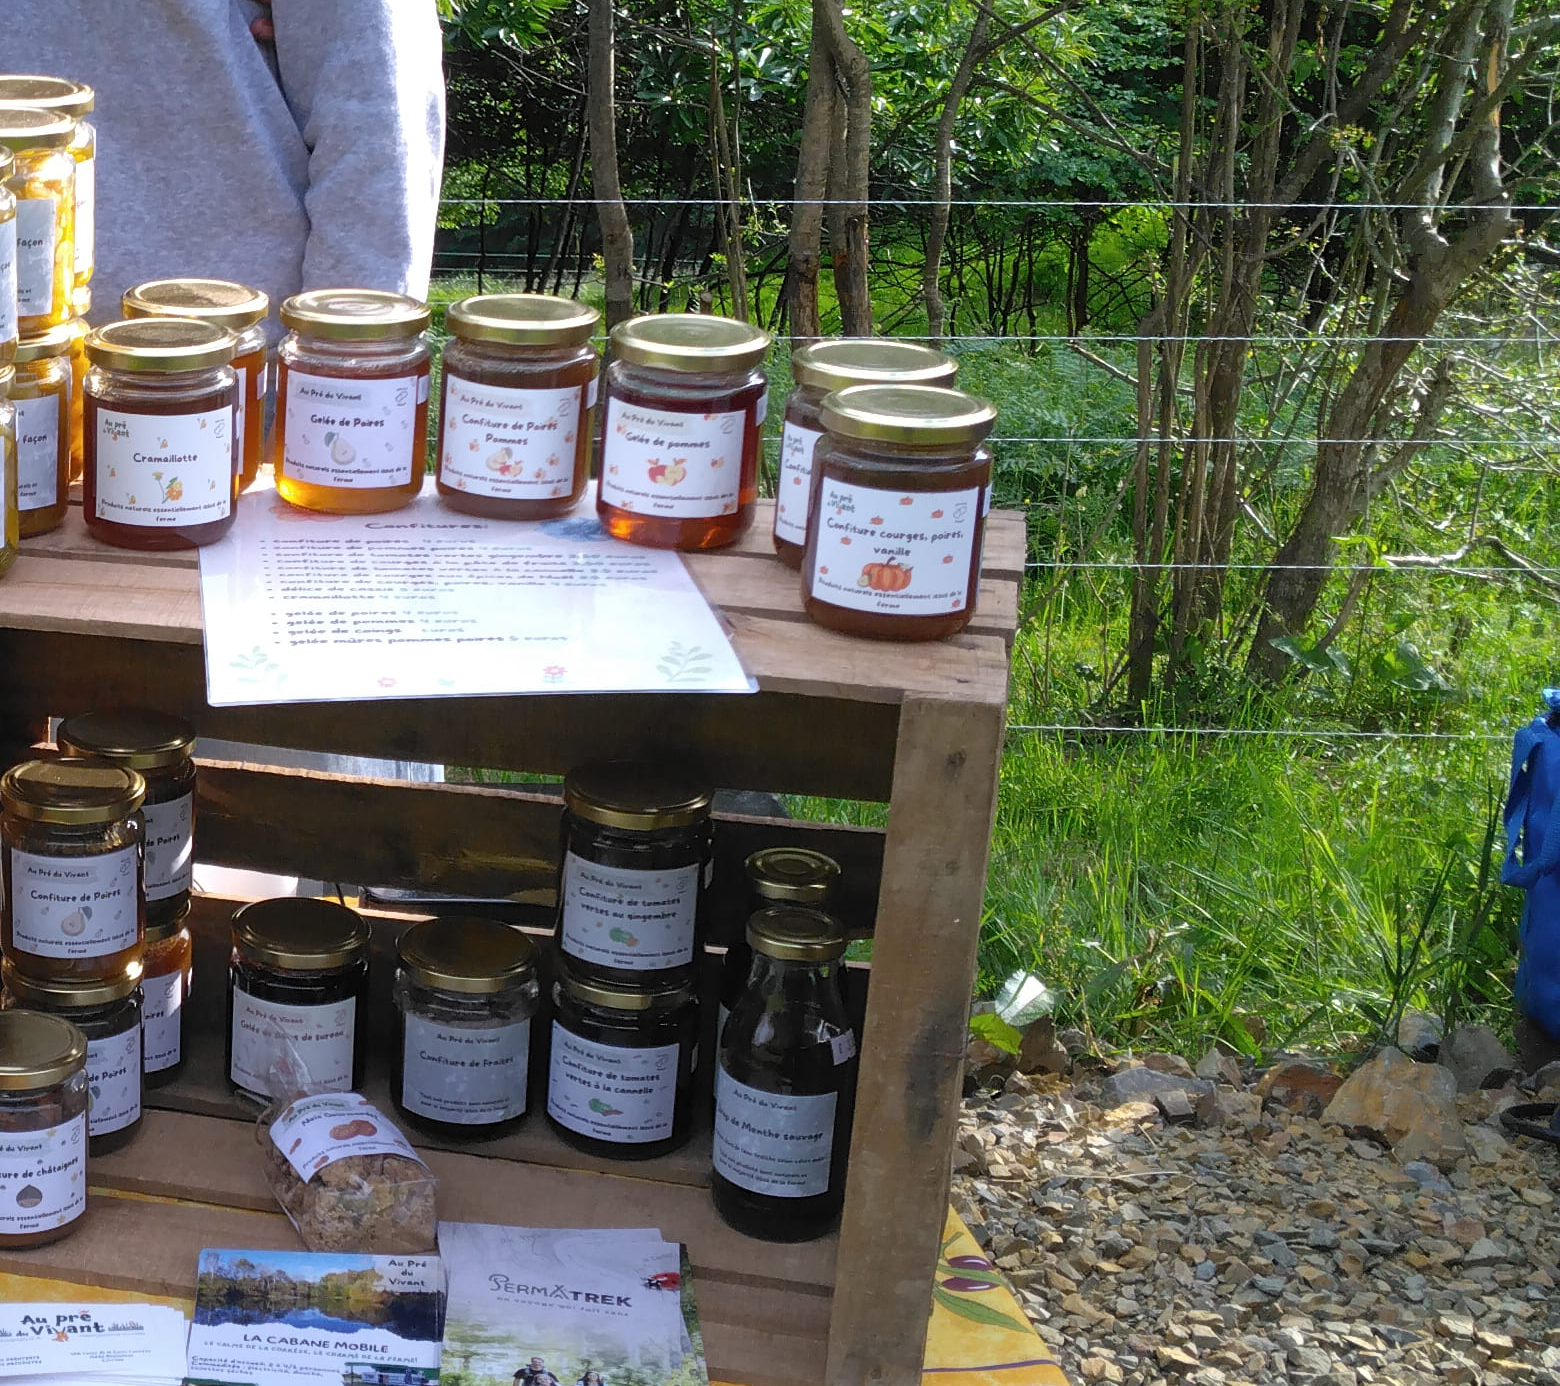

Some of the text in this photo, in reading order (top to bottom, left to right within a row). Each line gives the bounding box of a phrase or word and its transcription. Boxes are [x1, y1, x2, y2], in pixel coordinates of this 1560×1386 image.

[310, 414, 384, 427] Gelée de Poires
[625, 432, 710, 450] Gelée de pommes
[133, 453, 198, 463] Cramaillotte
[827, 517, 963, 544] Confiture courges, poires,
[873, 546, 911, 556] vanille
[30, 889, 121, 902] Confiture de Poires
[22, 1168, 34, 1178] de
[36, 1156, 78, 1177] châtaignes
[388, 1259, 427, 1268] Au Pré
[388, 1277, 426, 1287] Vivant
[20, 1314, 48, 1325] Au
[30, 1322, 106, 1336] Vivant
[243, 1333, 389, 1354] LA CABANE MOBILE
